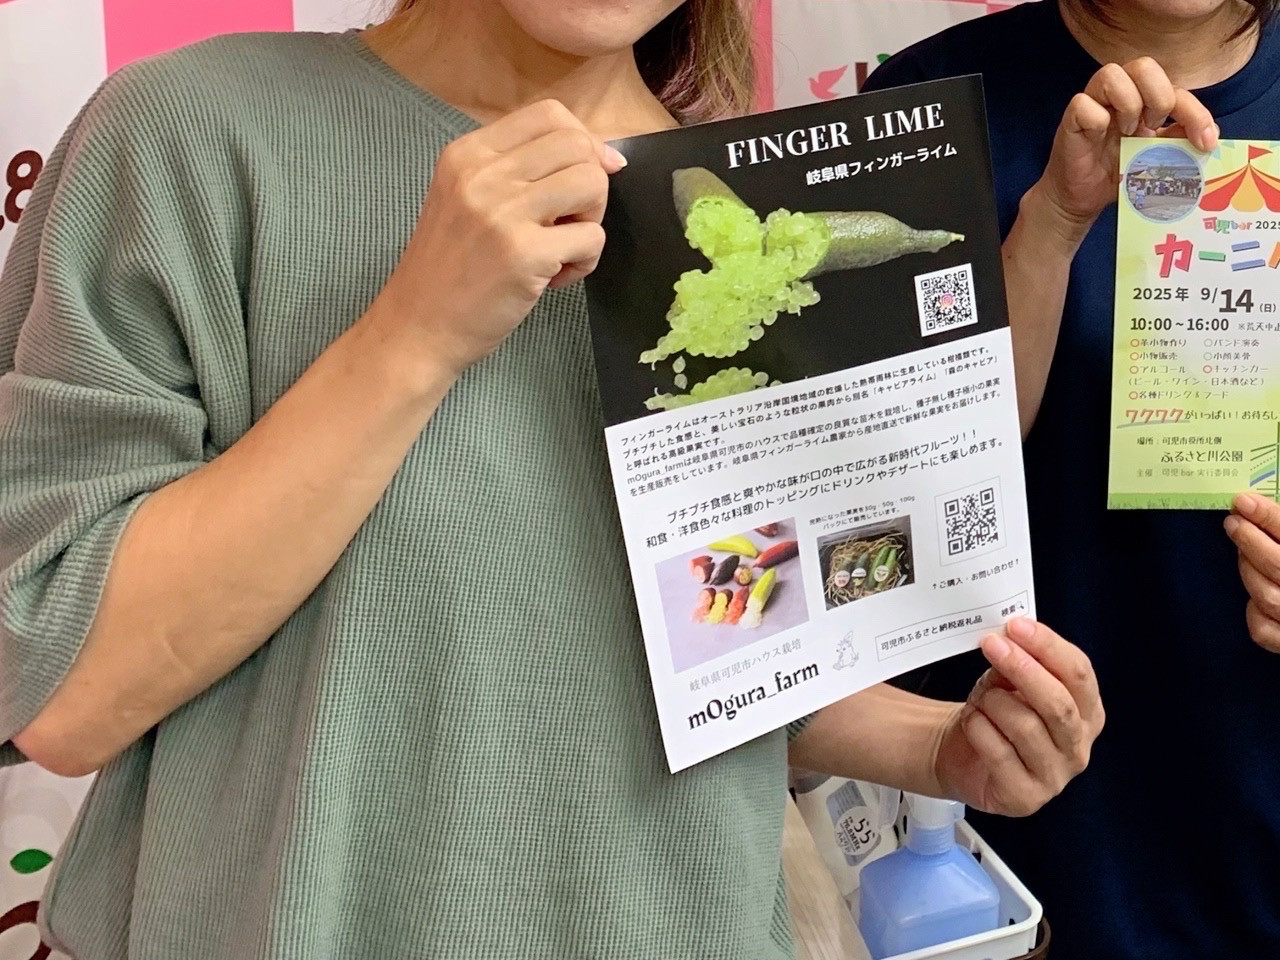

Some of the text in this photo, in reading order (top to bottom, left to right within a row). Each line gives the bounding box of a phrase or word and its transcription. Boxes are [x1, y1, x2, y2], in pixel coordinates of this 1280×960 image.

[725, 103, 945, 169] FINGER LIME
[806, 143, 958, 185] 岐阜県フィンガーライム
[1133, 287, 1189, 301] 2025年
[687, 663, 820, 730] mOgura_farm
